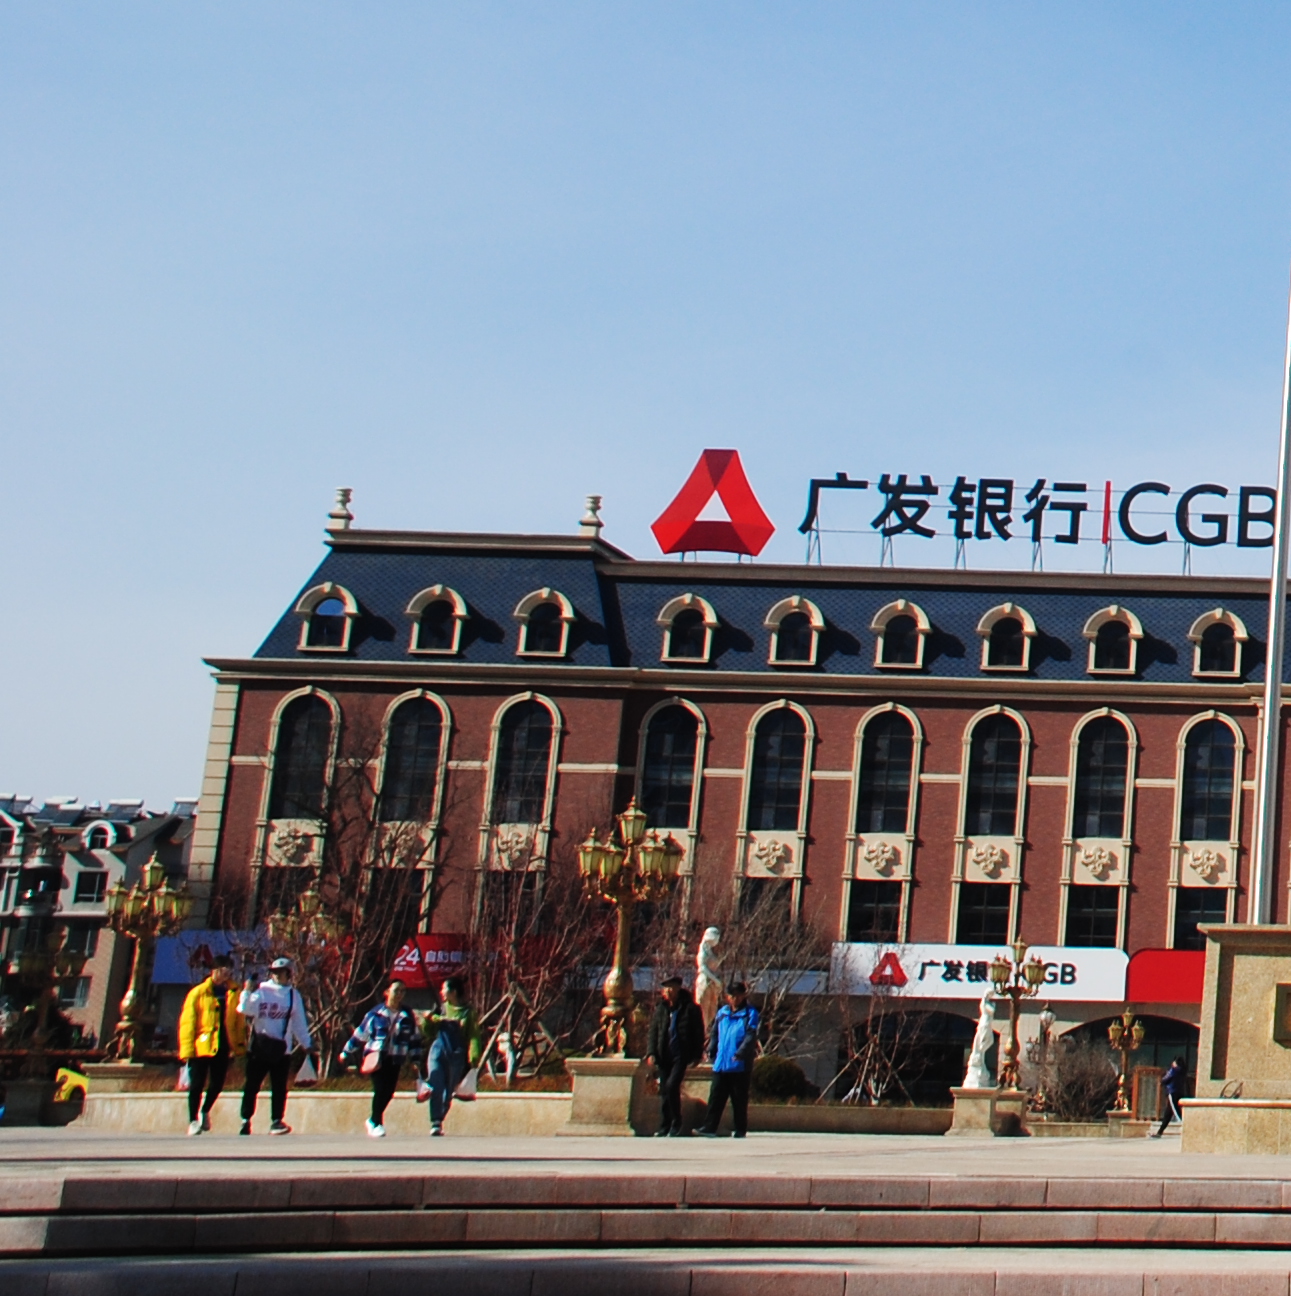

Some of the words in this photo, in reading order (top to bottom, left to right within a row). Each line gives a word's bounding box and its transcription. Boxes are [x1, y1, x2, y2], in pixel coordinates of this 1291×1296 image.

[798, 472, 1088, 544] 广发银行
[1118, 481, 1277, 548] CGB
[394, 945, 420, 966] 24
